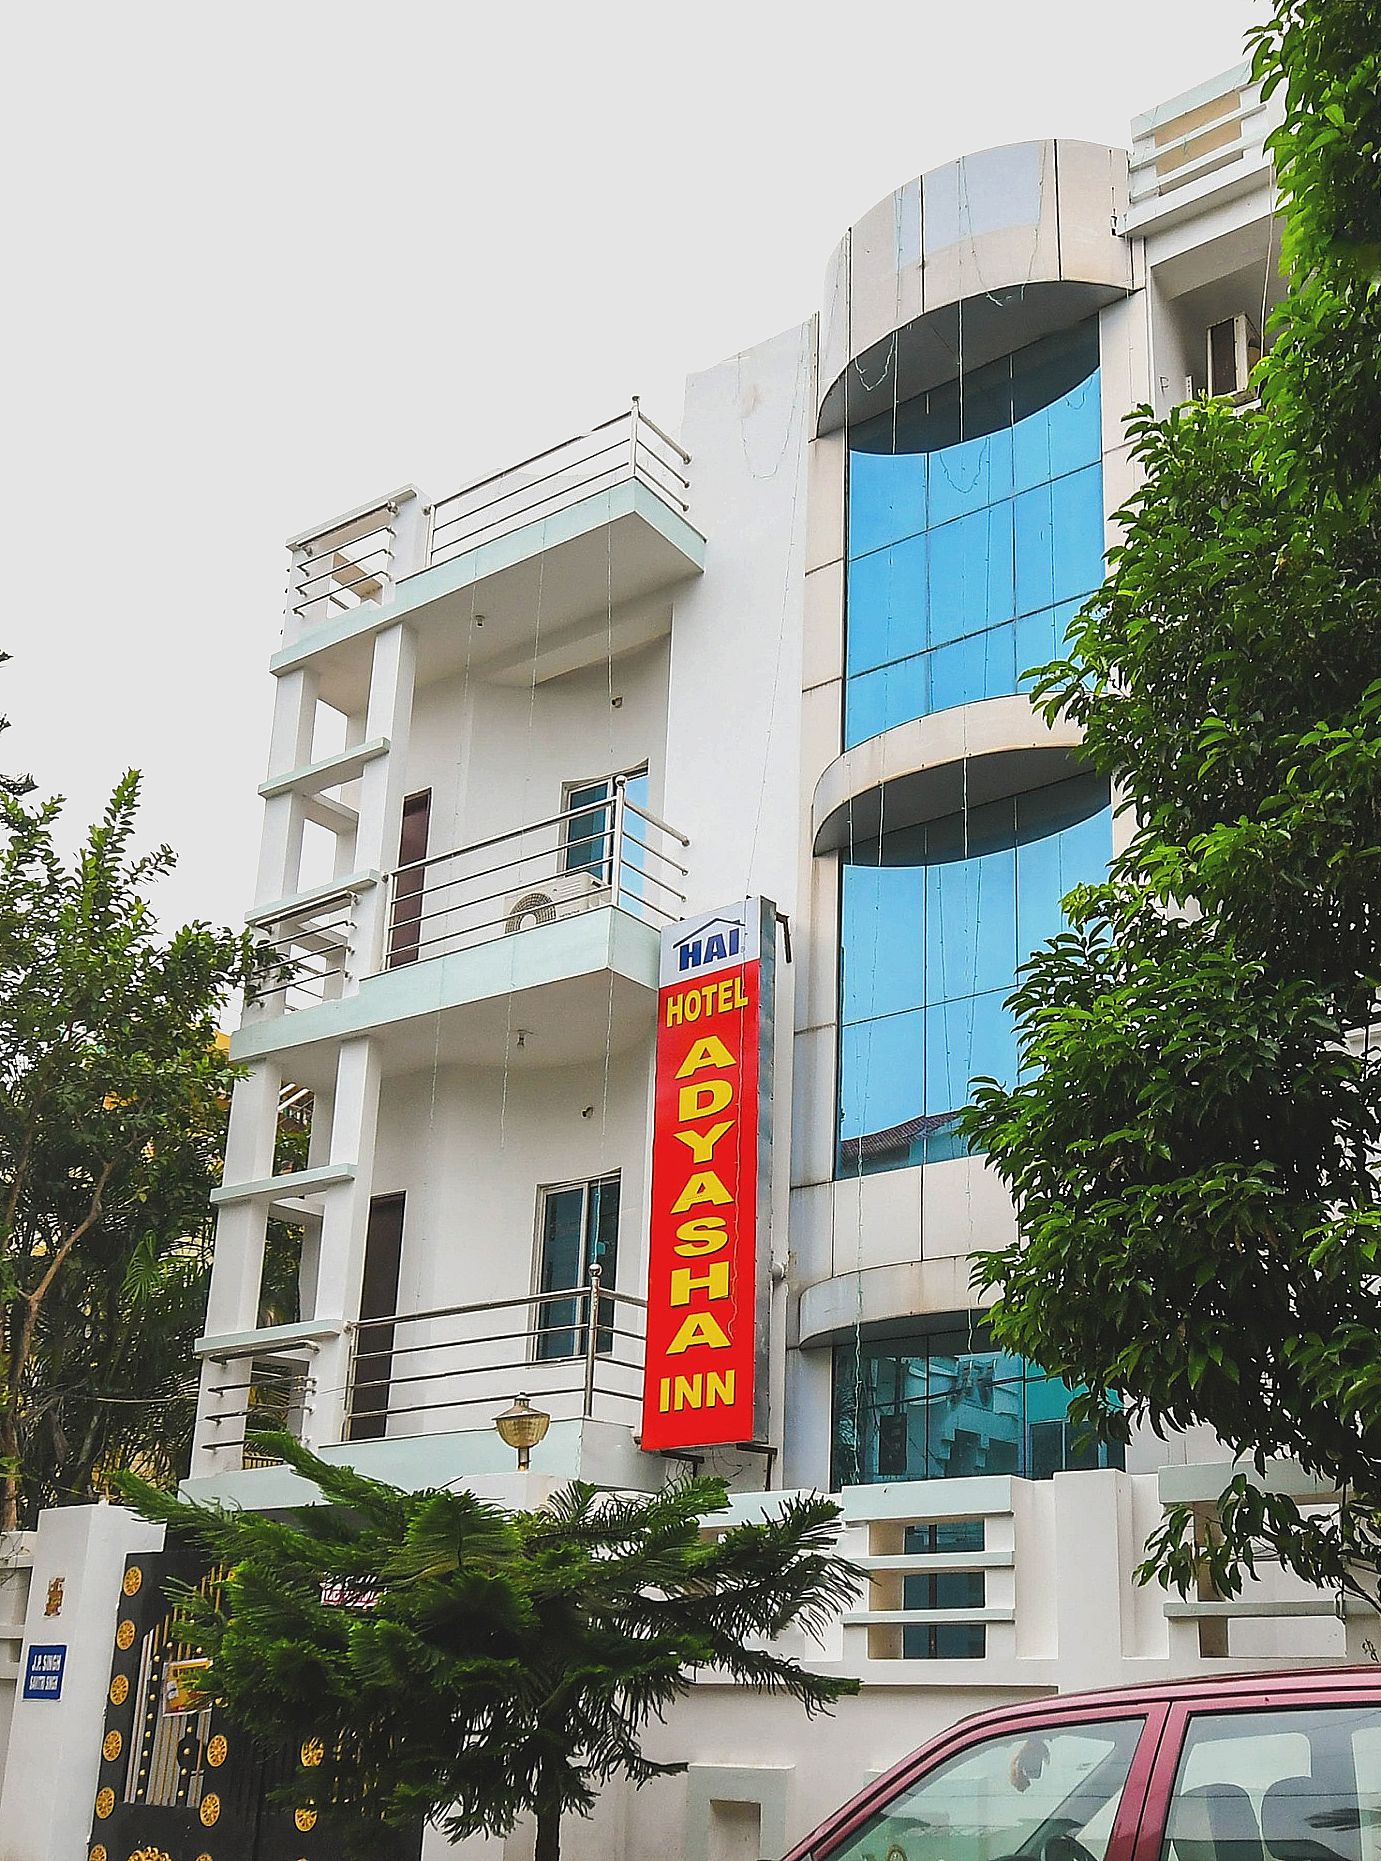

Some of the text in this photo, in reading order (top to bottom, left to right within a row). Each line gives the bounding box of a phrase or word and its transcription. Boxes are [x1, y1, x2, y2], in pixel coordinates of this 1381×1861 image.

[679, 927, 740, 972] HAI
[666, 976, 749, 1028] HOTEL
[665, 1034, 736, 1355] ADYASHA
[659, 1369, 735, 1412] INN
